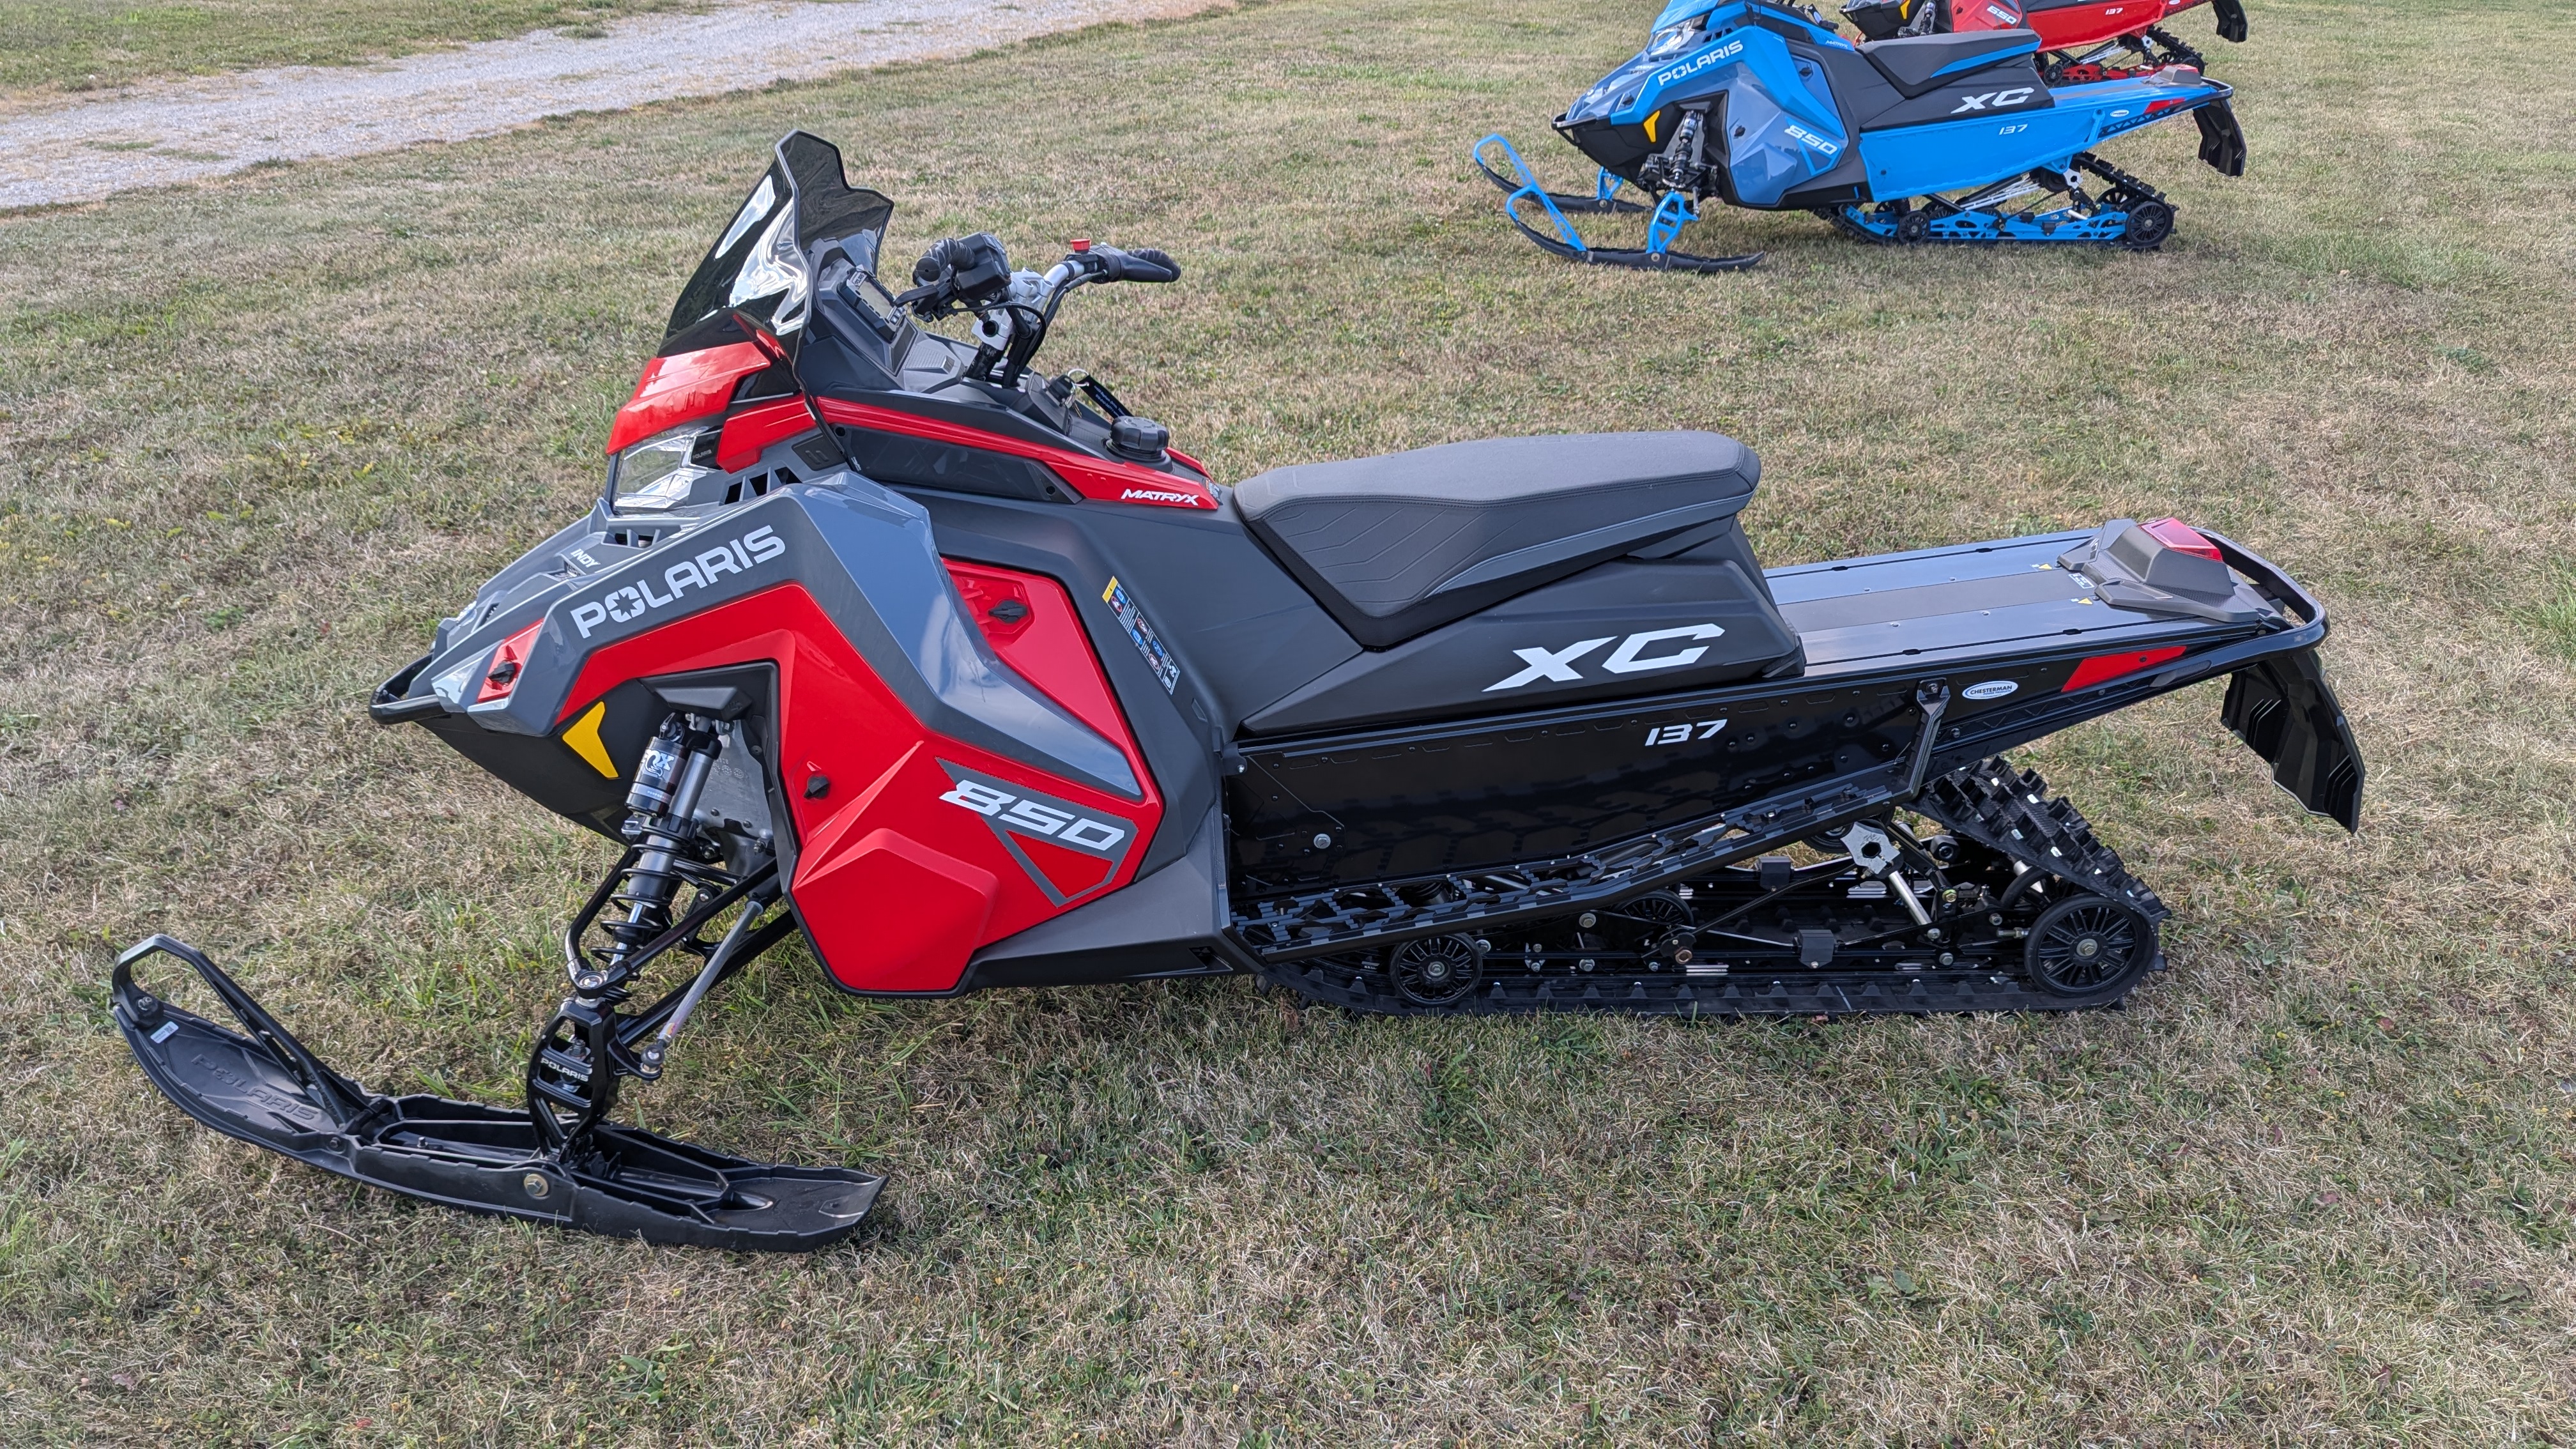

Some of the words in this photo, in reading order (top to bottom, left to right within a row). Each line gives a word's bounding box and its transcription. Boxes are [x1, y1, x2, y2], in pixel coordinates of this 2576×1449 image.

[1987, 5, 2017, 24] 650
[1658, 40, 1744, 86] POLARIS
[1951, 87, 2035, 114] XC
[1784, 125, 1838, 155] 850
[1998, 123, 2028, 135] 137
[1121, 489, 1199, 506] MATRYX
[570, 548, 601, 568] INDY
[570, 525, 786, 638] POLARIS
[1481, 623, 1726, 692] XC
[1970, 685, 2012, 695] CHESTERMAN
[1644, 719, 1728, 746] 137
[939, 779, 1125, 851] 850
[540, 1057, 589, 1082] POLARIS
[190, 1054, 319, 1121] POLARIS
